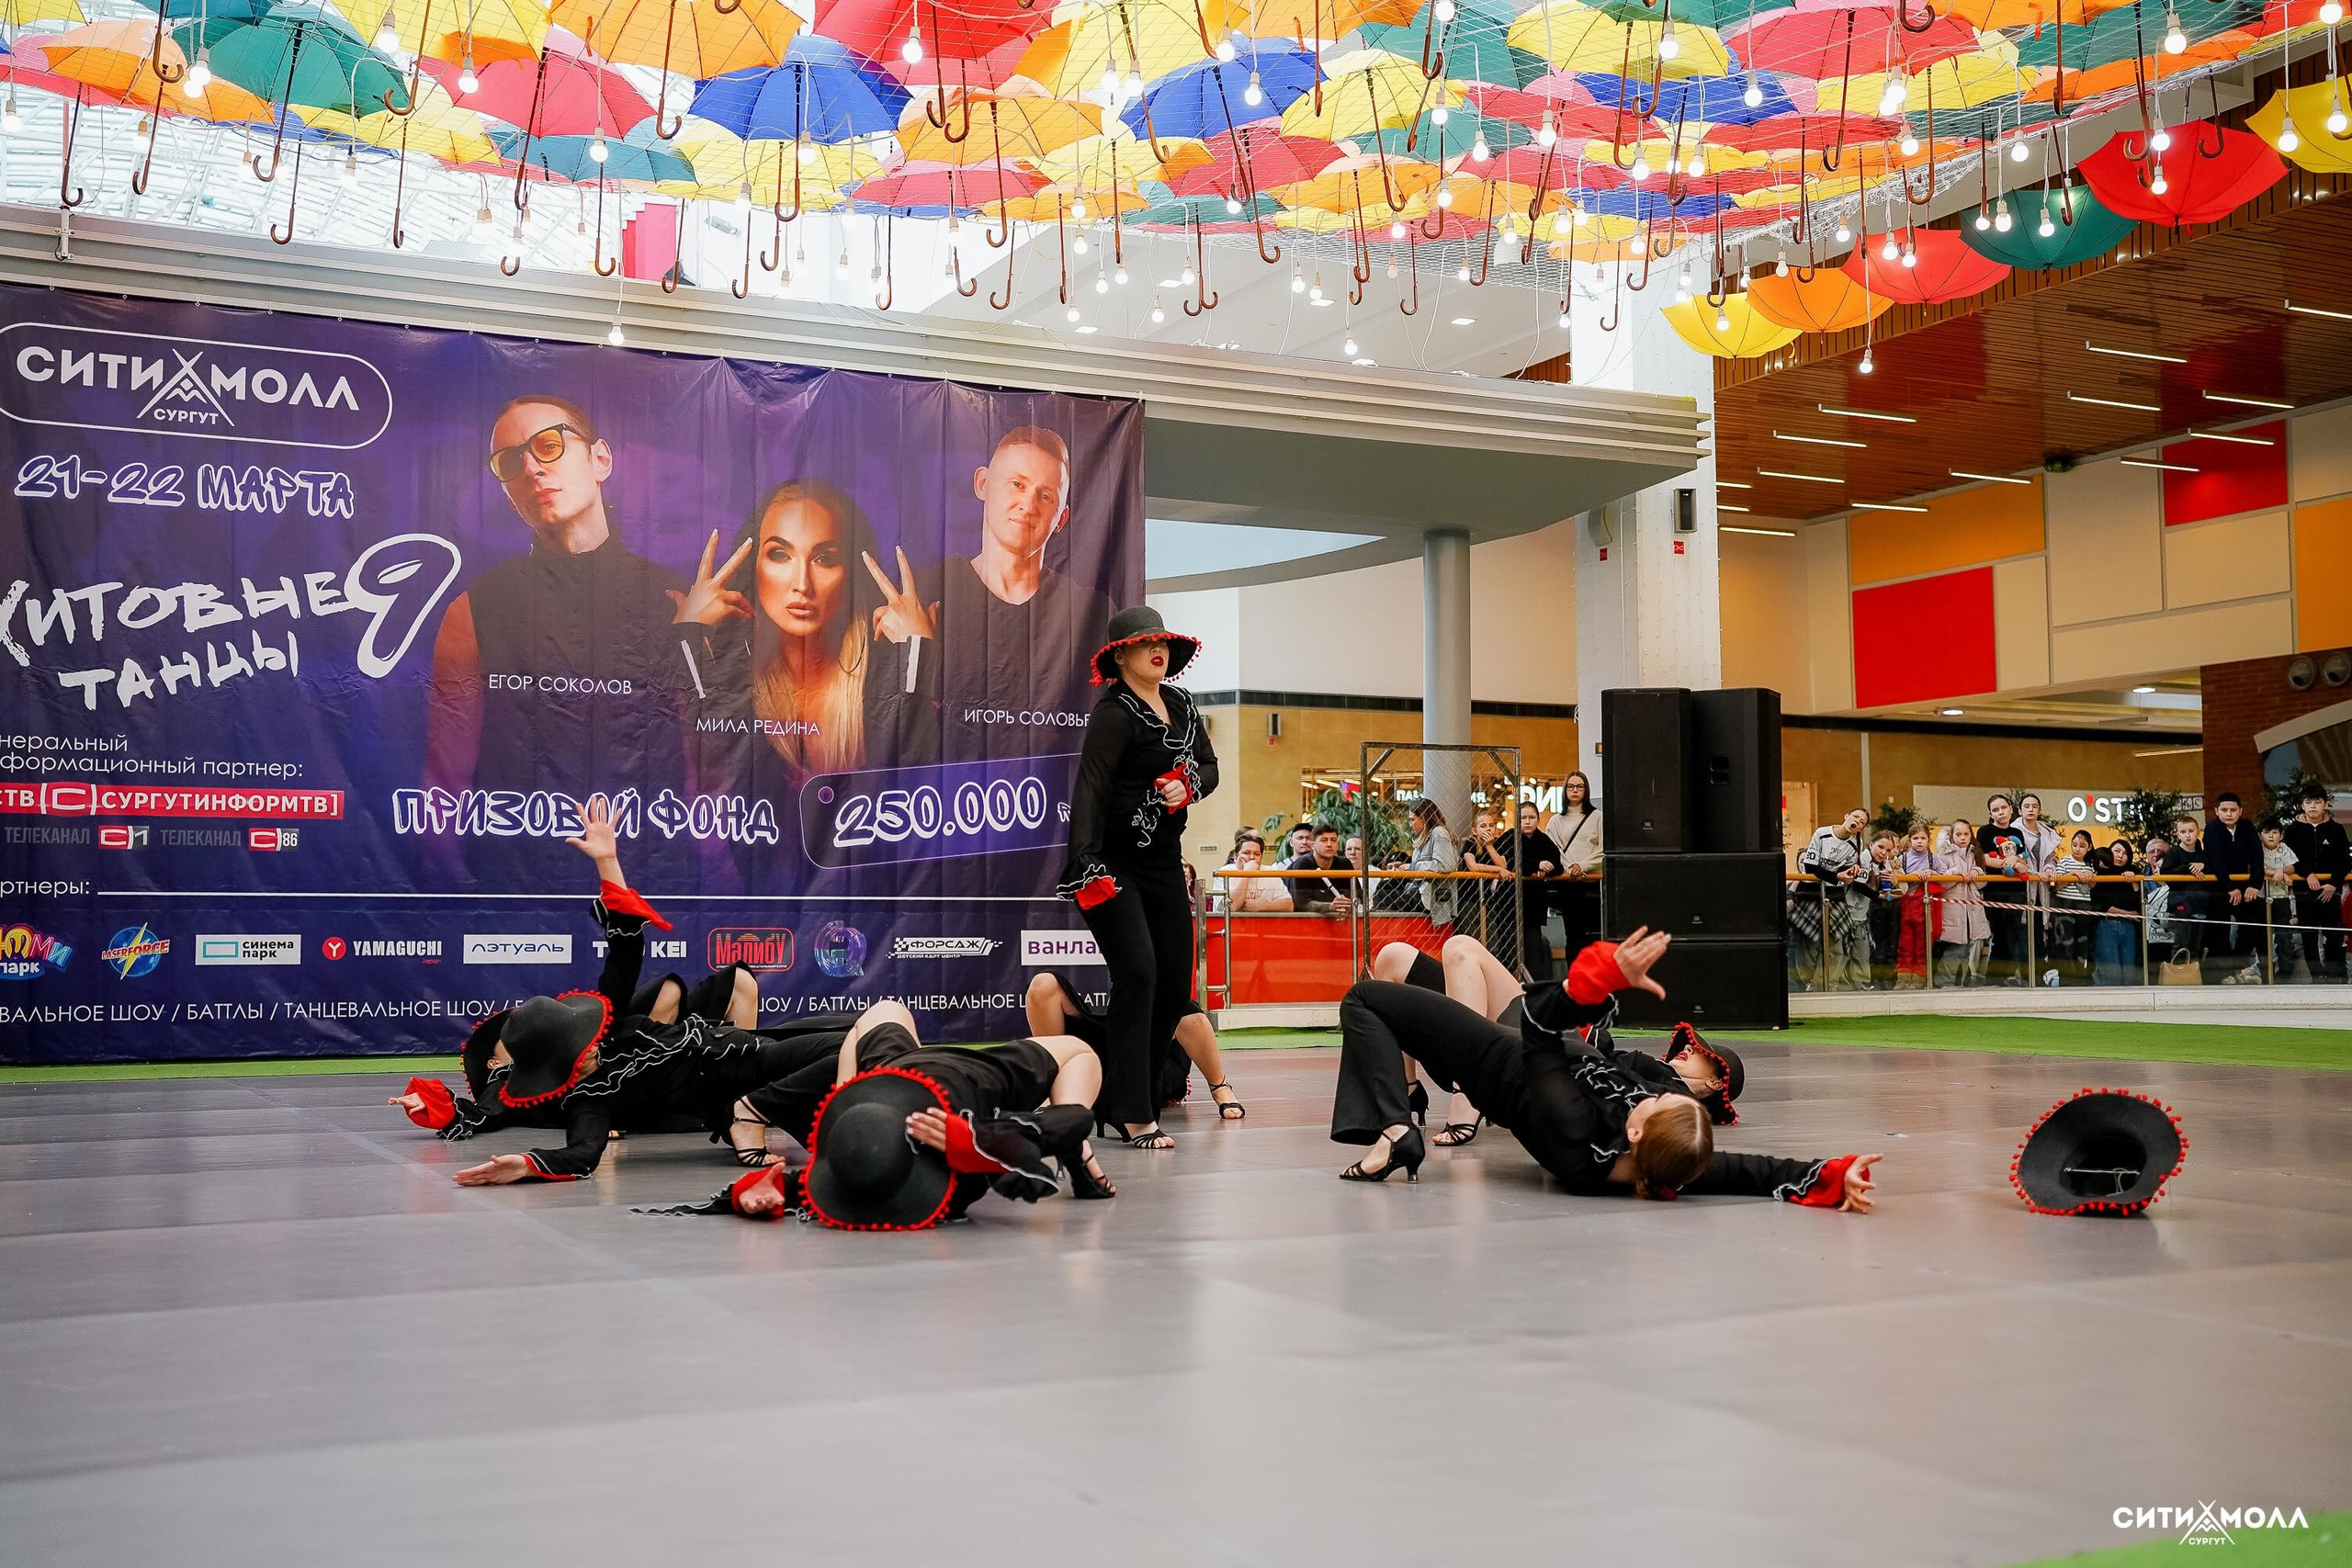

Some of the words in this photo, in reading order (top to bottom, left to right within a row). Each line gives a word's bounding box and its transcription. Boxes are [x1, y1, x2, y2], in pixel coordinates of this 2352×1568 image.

[17, 345, 164, 390] СИТИ
[210, 364, 360, 411] МОЛЛ
[153, 408, 219, 426] СУРГУТ
[14, 455, 186, 508] 21-22
[197, 464, 355, 519] МАРТА
[59, 630, 299, 711] ТАНЦЫ
[489, 674, 533, 691] ЕГОР
[538, 676, 633, 695] СОКОЛОВ
[696, 717, 749, 734] МИЛА
[753, 719, 820, 736] РЕДИНА
[965, 708, 1015, 724] ИГОРЬ
[1019, 710, 1091, 728] СОЛОВЬЕ
[0, 751, 196, 775] формационный
[203, 759, 303, 781] партнер:
[0, 790, 35, 807] ТВ
[648, 788, 779, 845] ФОНД
[832, 776, 1047, 849] 250.000
[5, 827, 91, 845] ТЕЛЕКАНАЛ
[160, 829, 242, 847] ТЕЛЕКАНАЛ
[0, 880, 90, 898] ртнеры:
[101, 939, 171, 961] LASERFORCE
[243, 941, 294, 949] синема
[353, 941, 442, 957] YAMAGUCHI
[650, 941, 687, 958] KEI
[910, 941, 980, 949] ФОРСАЖ
[1028, 941, 1102, 955] ванла
[243, 949, 277, 961] парк
[0, 1005, 104, 1022] ВАЛЬНОЕ
[110, 1004, 165, 1022] ШОУ
[187, 1003, 264, 1020] БАТТЛЫ
[284, 1000, 441, 1021] ТАНЦЕВАЛЬНОЕ
[447, 1000, 495, 1018] ШОУ
[808, 996, 870, 1011] БАТТЛЫ
